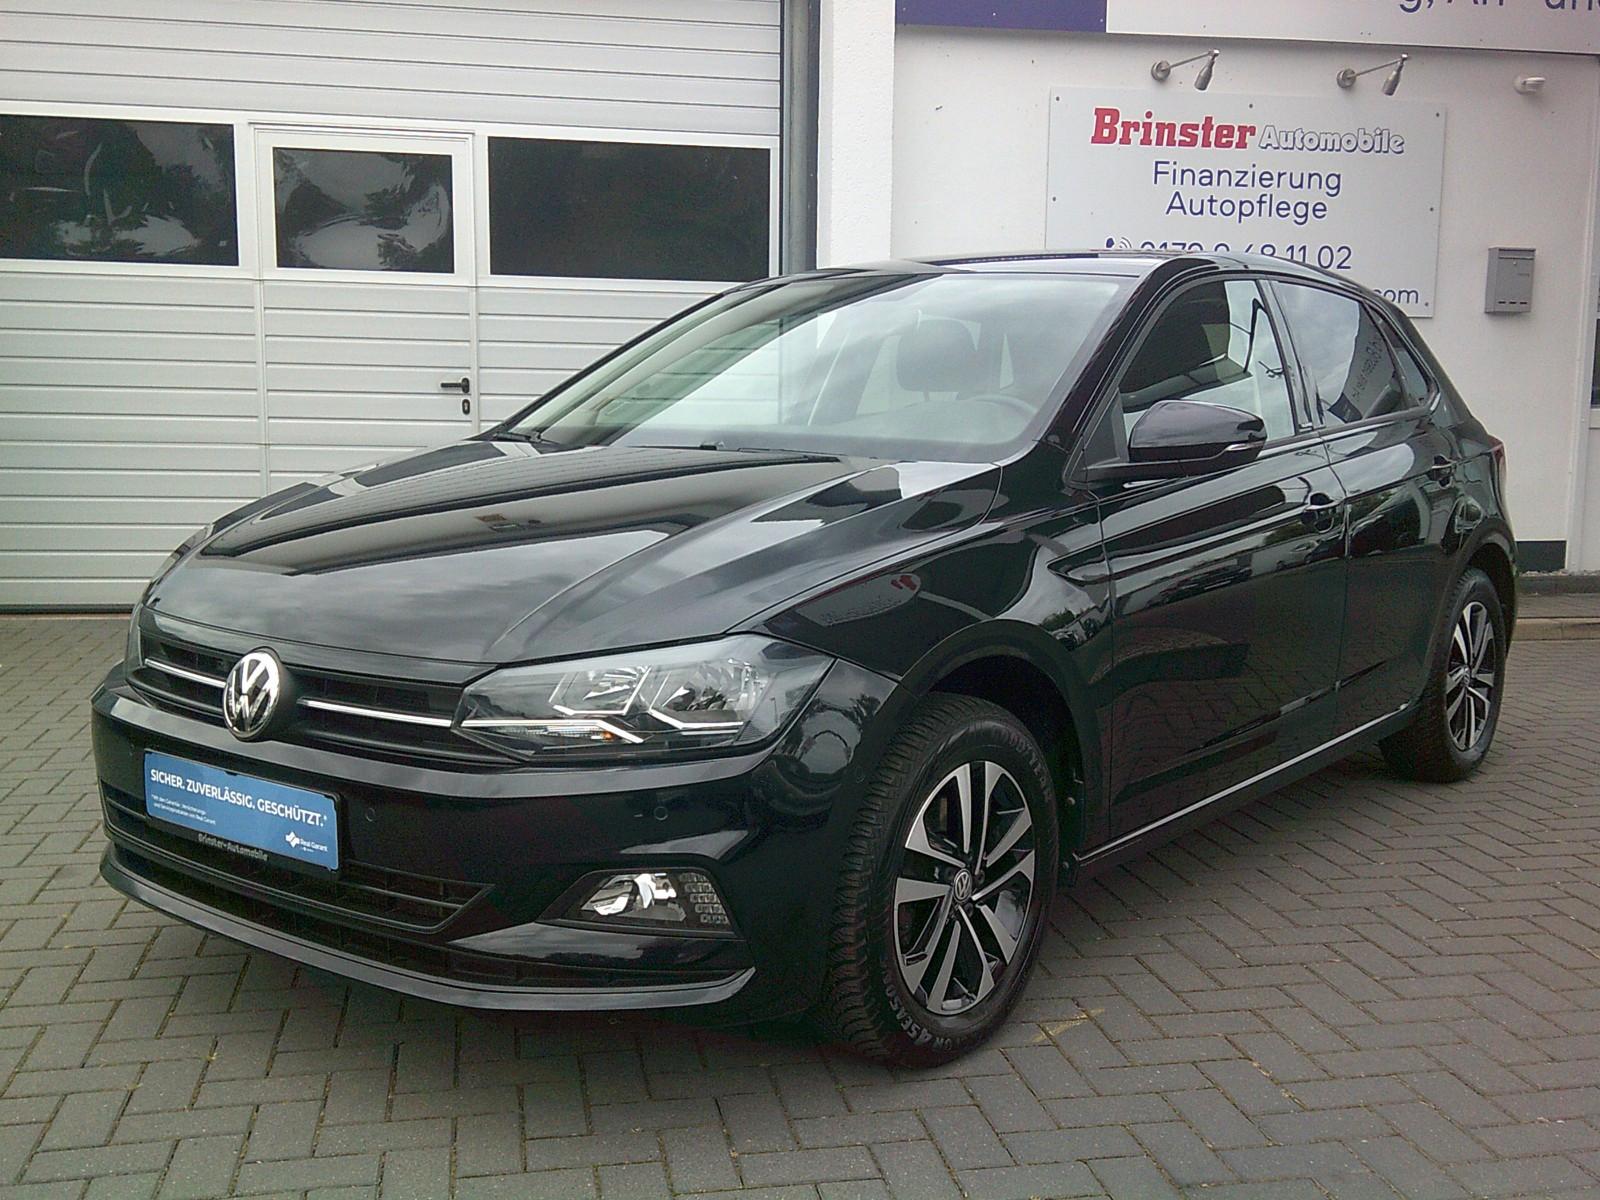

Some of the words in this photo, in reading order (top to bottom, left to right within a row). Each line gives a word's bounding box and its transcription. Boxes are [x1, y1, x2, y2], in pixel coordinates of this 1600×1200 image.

[1090, 107, 1256, 150] Brinster
[1258, 124, 1405, 154] Automobile
[1152, 160, 1342, 197] Finanzierung
[1165, 191, 1328, 225] Autopflege
[1317, 245, 1352, 270] 02
[1374, 288, 1419, 304] om
[150, 768, 186, 790] SICHER.
[186, 778, 256, 809] ZUVERLÄSSIG.
